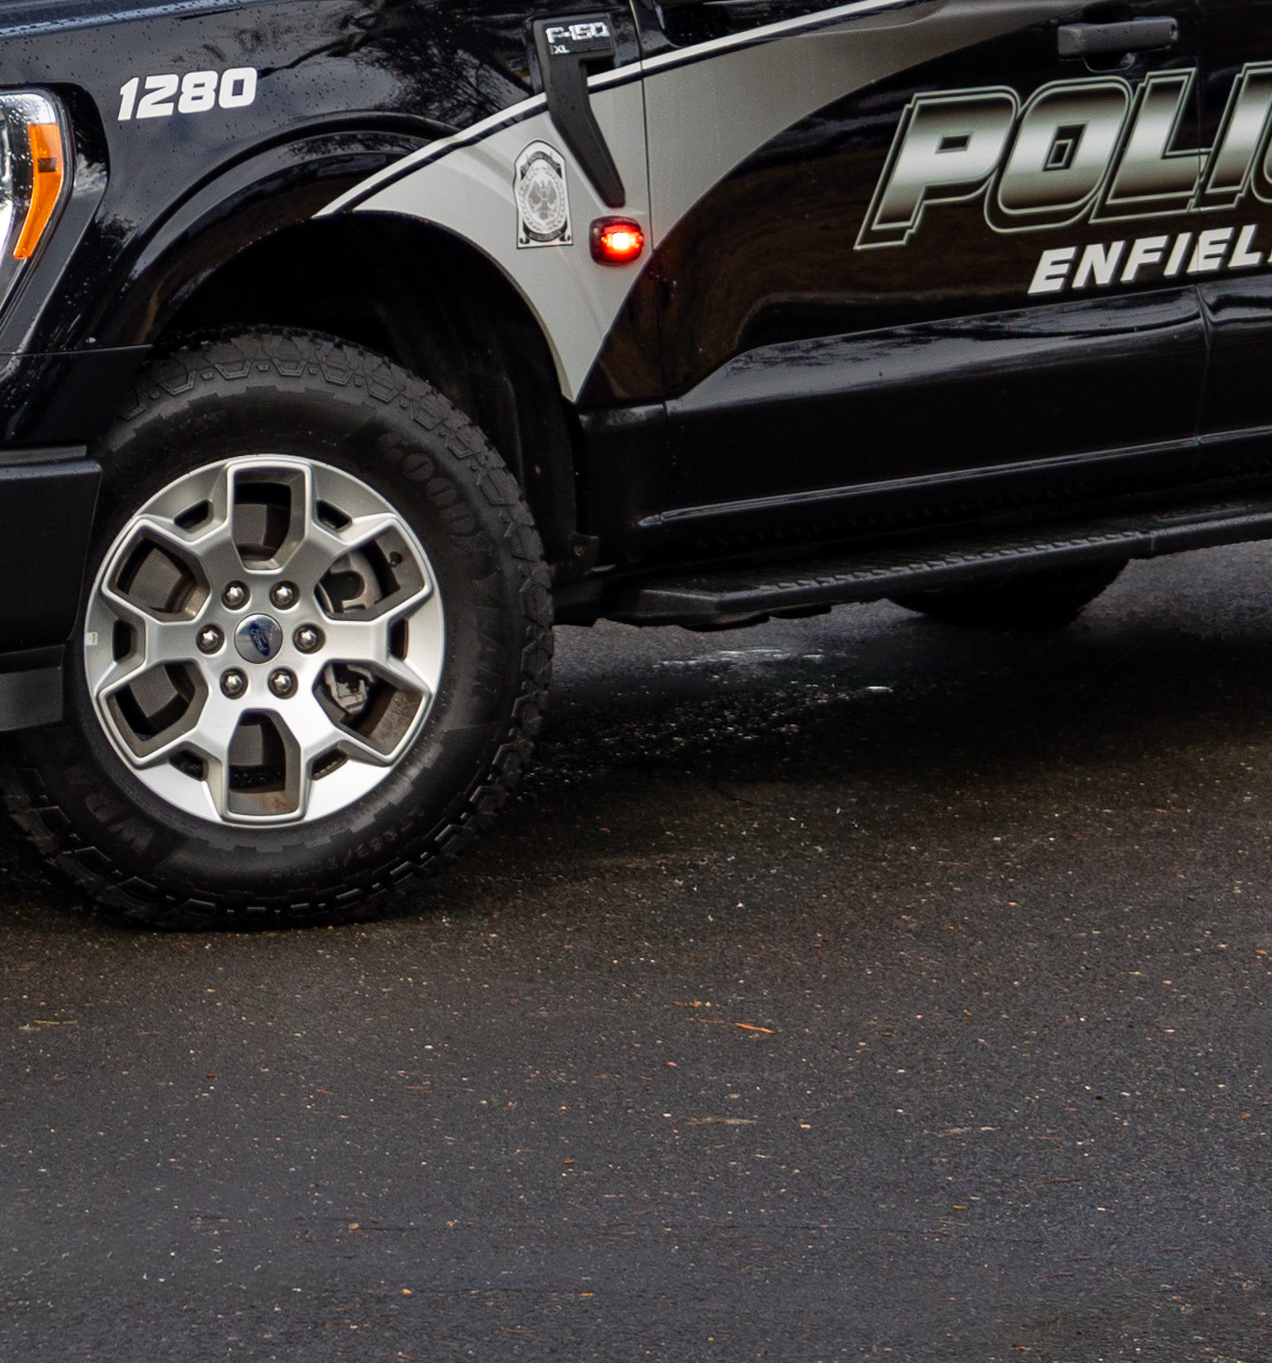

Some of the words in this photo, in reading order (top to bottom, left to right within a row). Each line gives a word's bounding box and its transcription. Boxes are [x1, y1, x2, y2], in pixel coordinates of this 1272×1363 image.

[545, 21, 610, 44] F-150
[553, 44, 570, 55] XL
[117, 66, 258, 121] 1280
